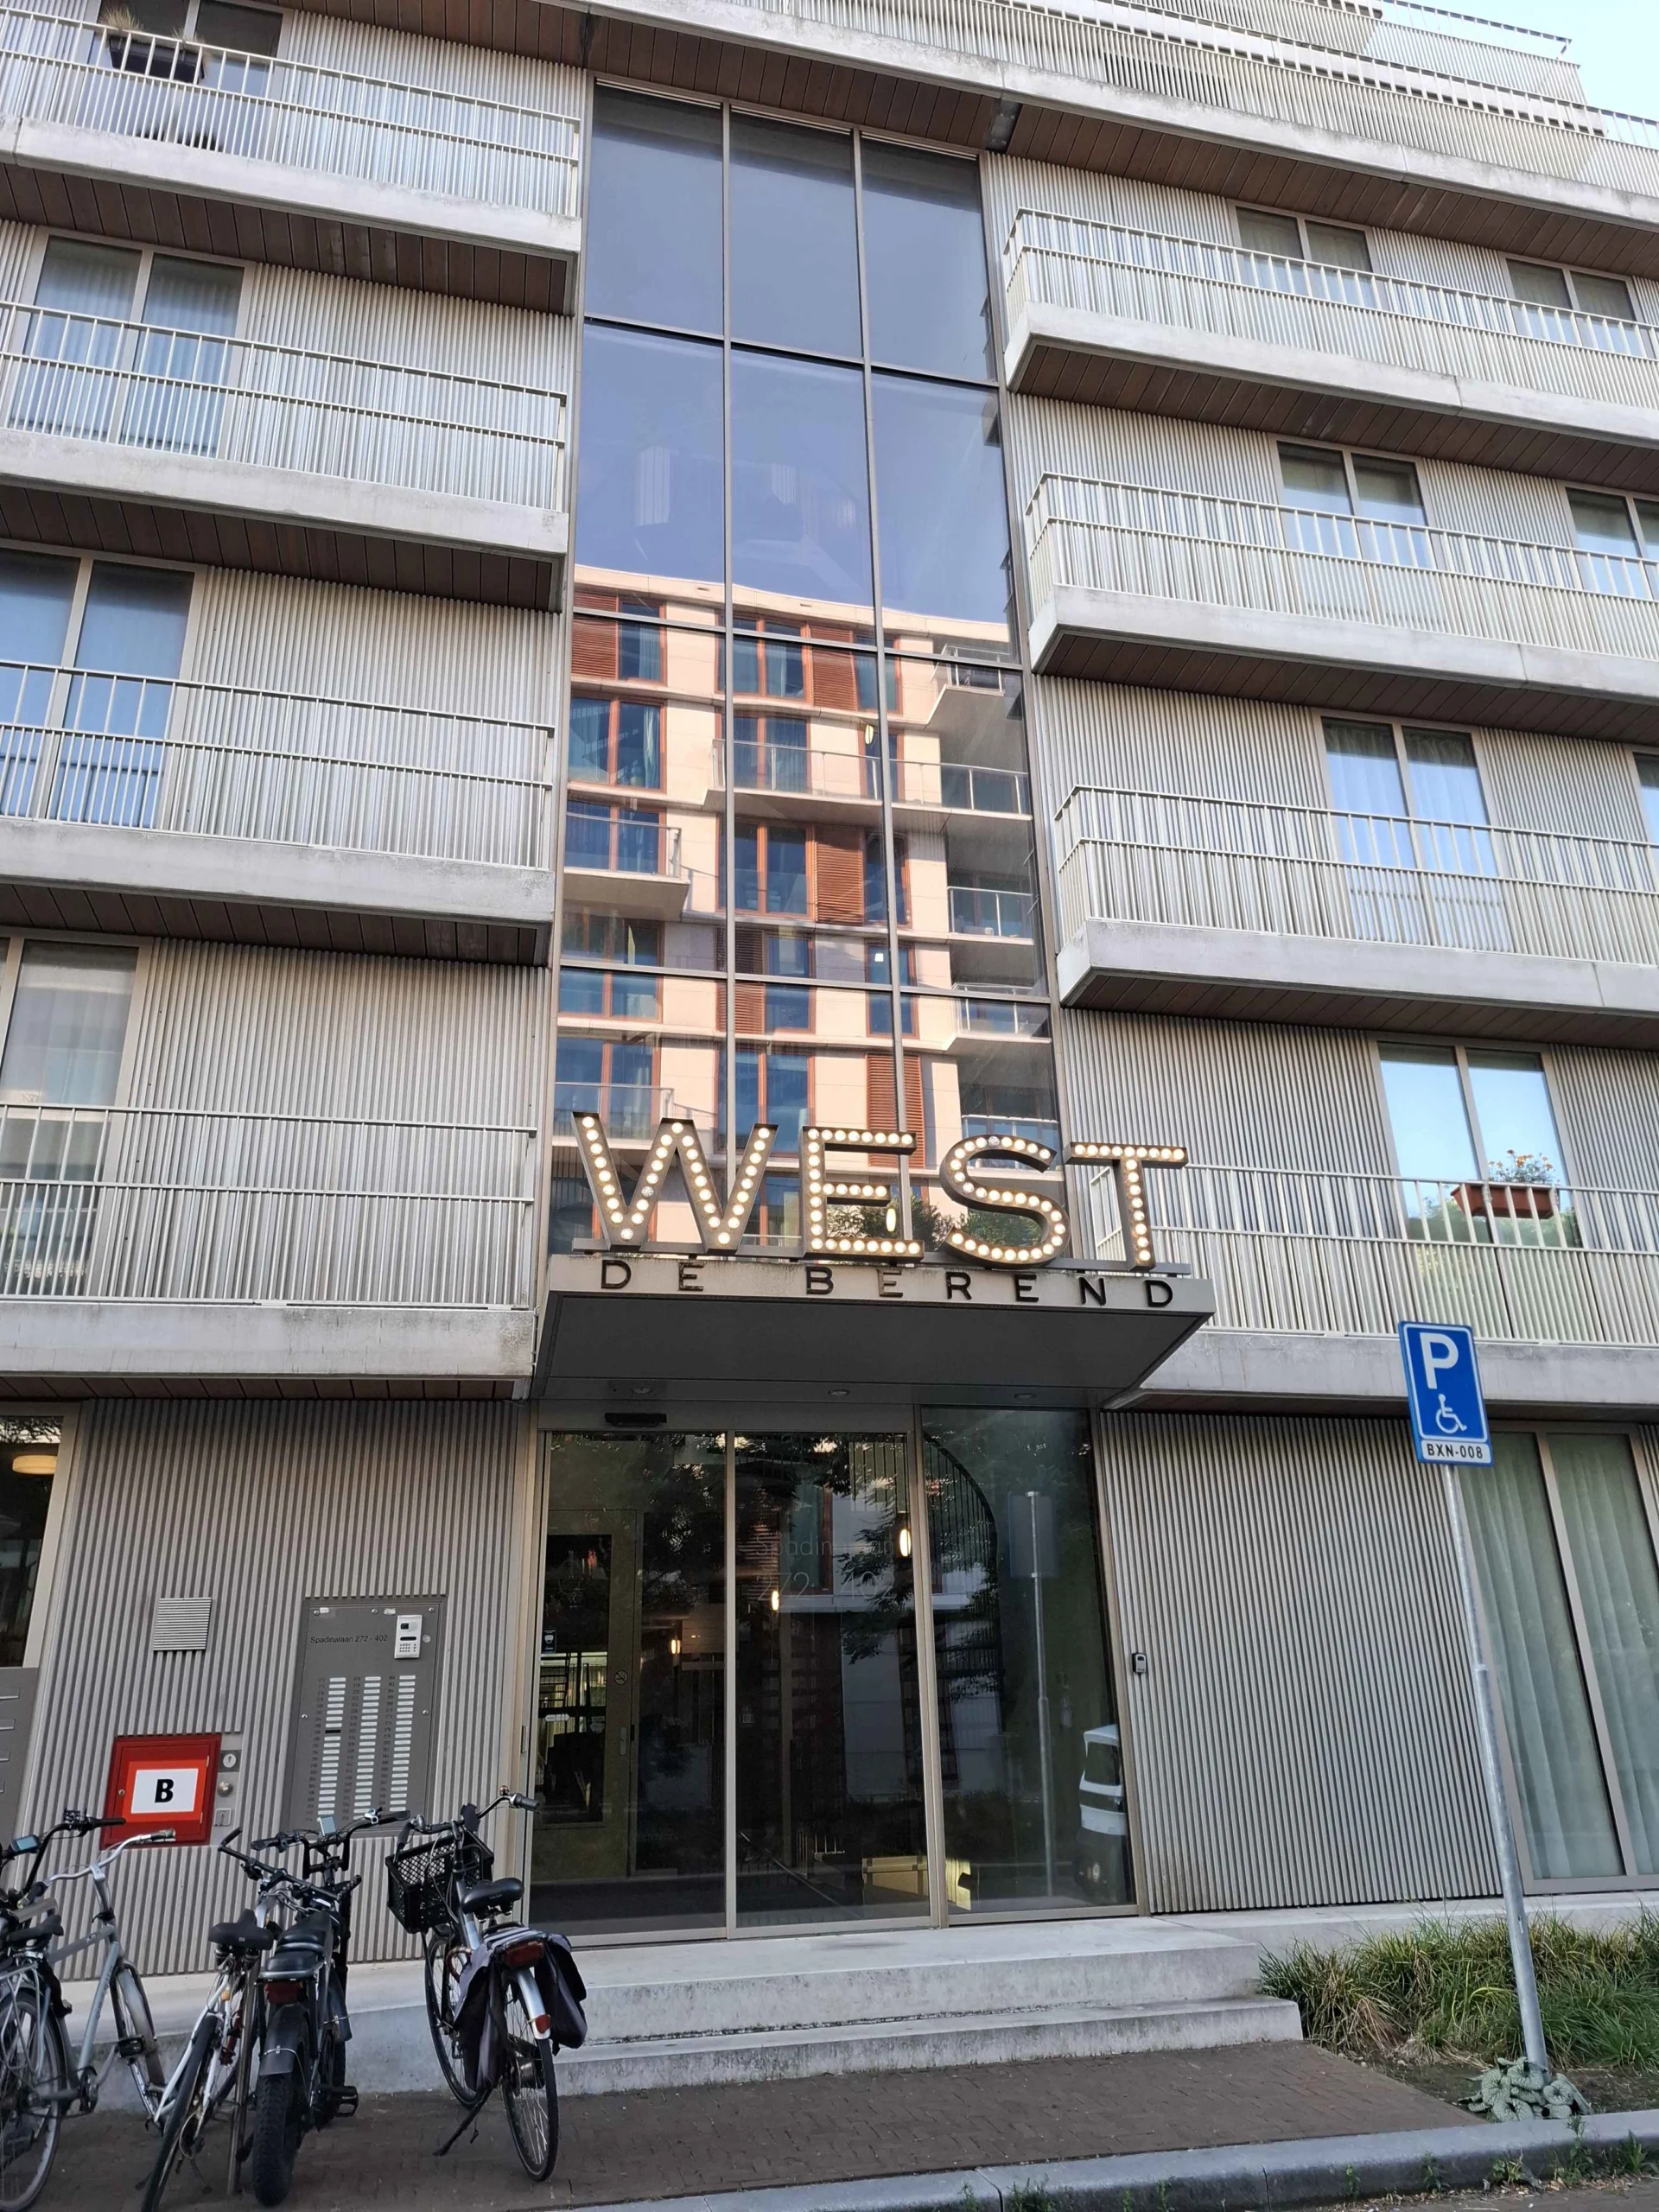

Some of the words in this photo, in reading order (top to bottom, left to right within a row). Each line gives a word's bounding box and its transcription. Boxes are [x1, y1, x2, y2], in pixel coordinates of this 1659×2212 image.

[571, 1111, 1188, 1272] WEST
[601, 1259, 703, 1292] DE
[805, 1266, 1173, 1308] BEREND
[1420, 1332, 1459, 1389] P
[1427, 1443, 1483, 1459] BXN-008
[840, 1571, 896, 1600] 402
[310, 1636, 353, 1644] Spadinalaan
[155, 1778, 175, 1803] B
